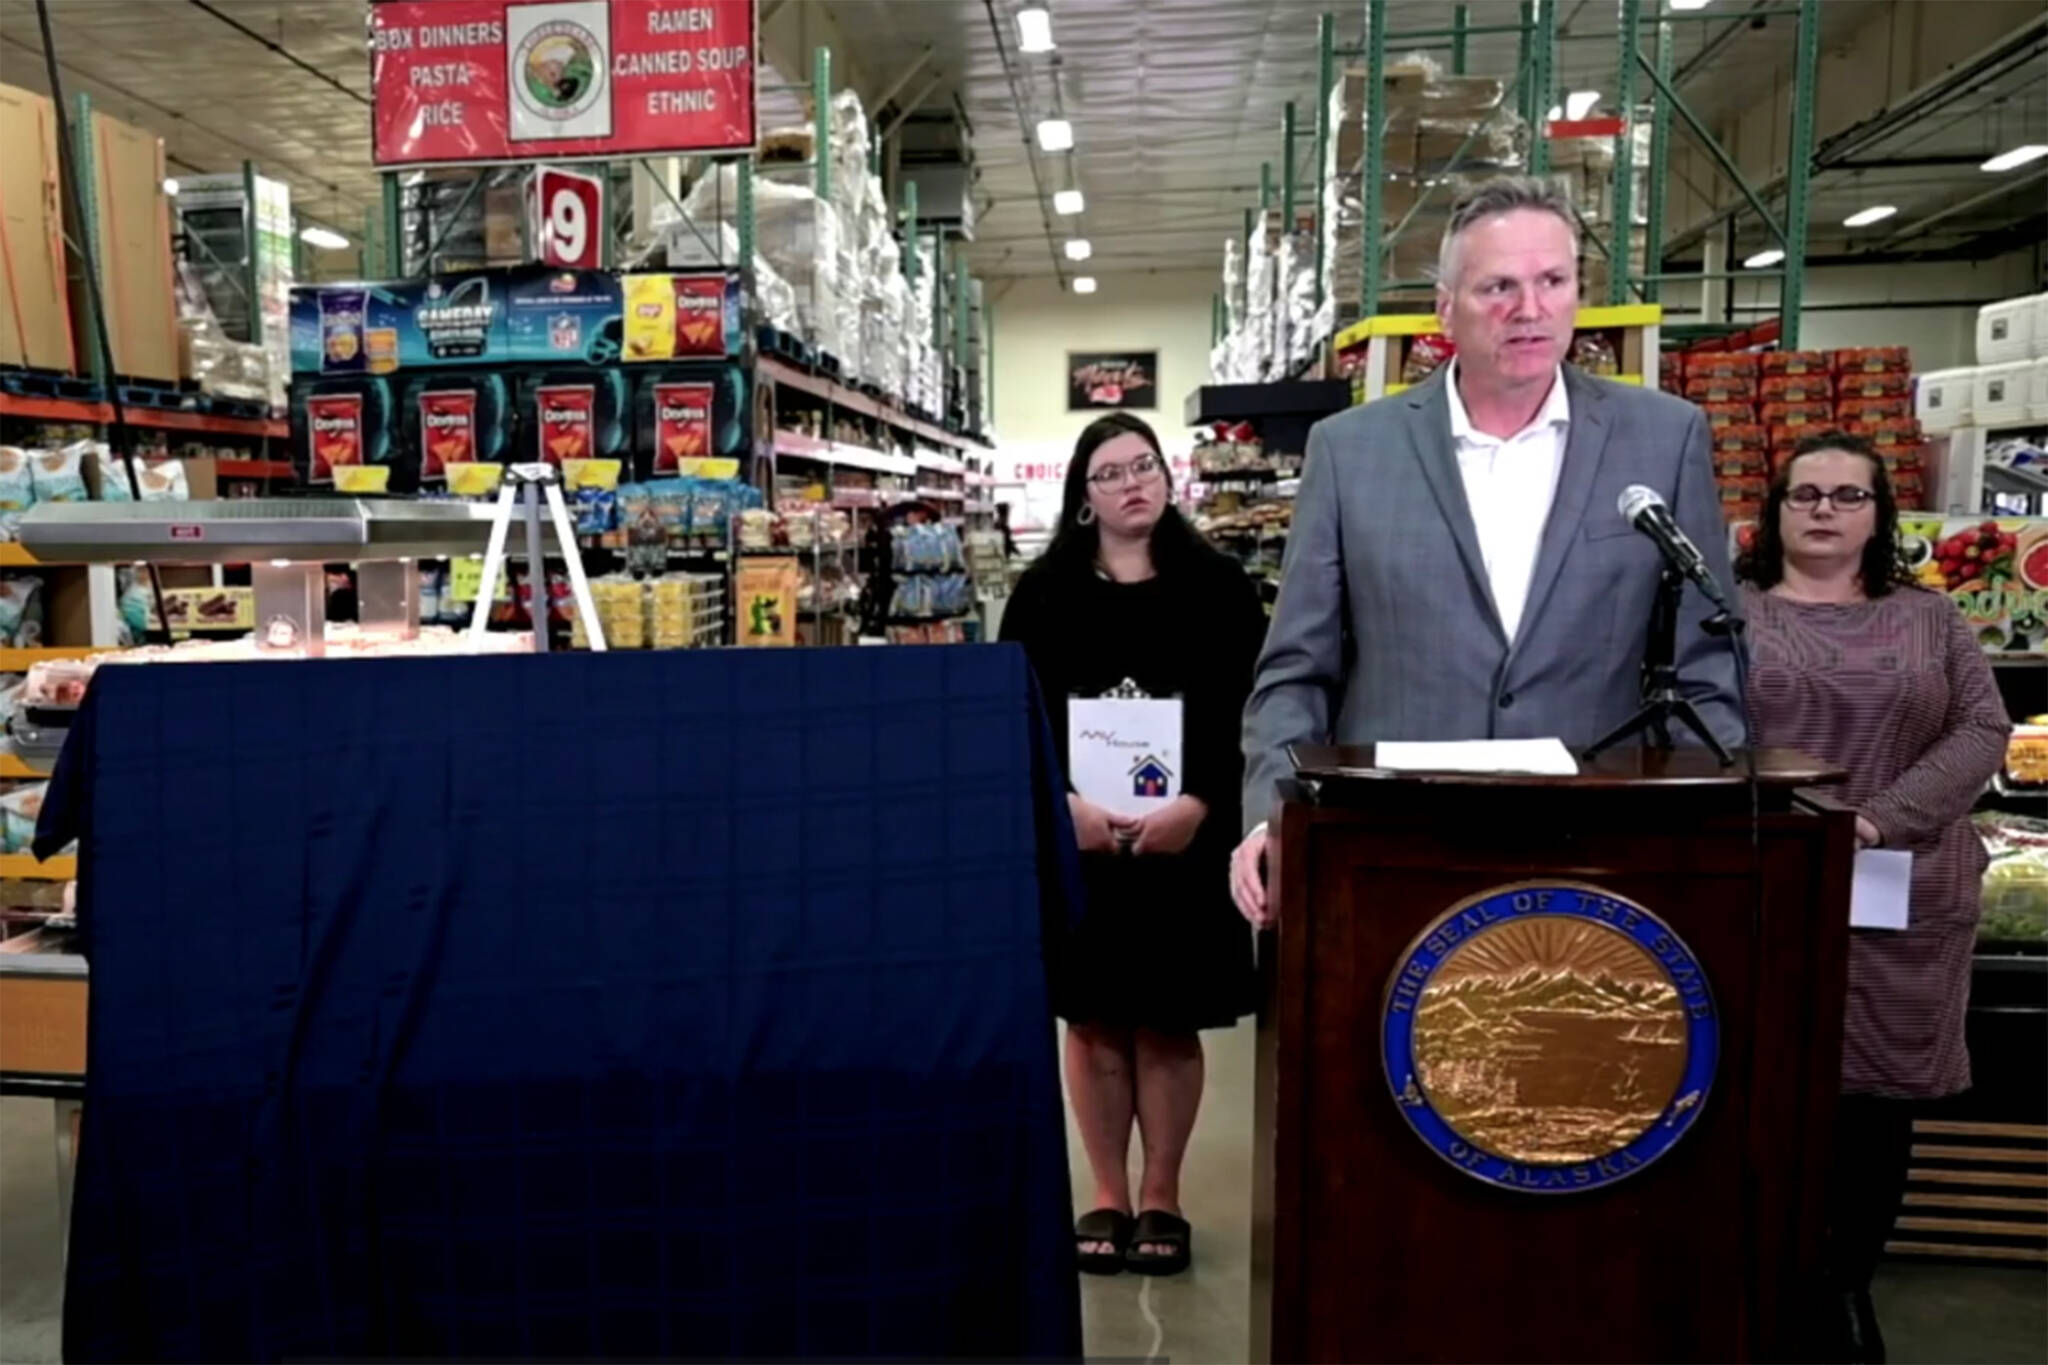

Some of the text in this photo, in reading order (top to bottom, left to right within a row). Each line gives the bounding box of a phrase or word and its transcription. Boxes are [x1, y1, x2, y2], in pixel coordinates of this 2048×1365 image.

[647, 7, 714, 35] RAMEN
[375, 27, 413, 51] BOX
[419, 21, 503, 48] DINNERS
[409, 62, 470, 88] PASTA
[614, 45, 747, 76] CANNED SOUP
[421, 101, 464, 126] RICE
[647, 87, 717, 115] ETHNIC
[551, 187, 587, 263] 9
[1014, 463, 1062, 480] CHOIC
[1392, 892, 1713, 1020] THE SEAL OF THE STATE
[1448, 1140, 1642, 1186] OF ALASKA
